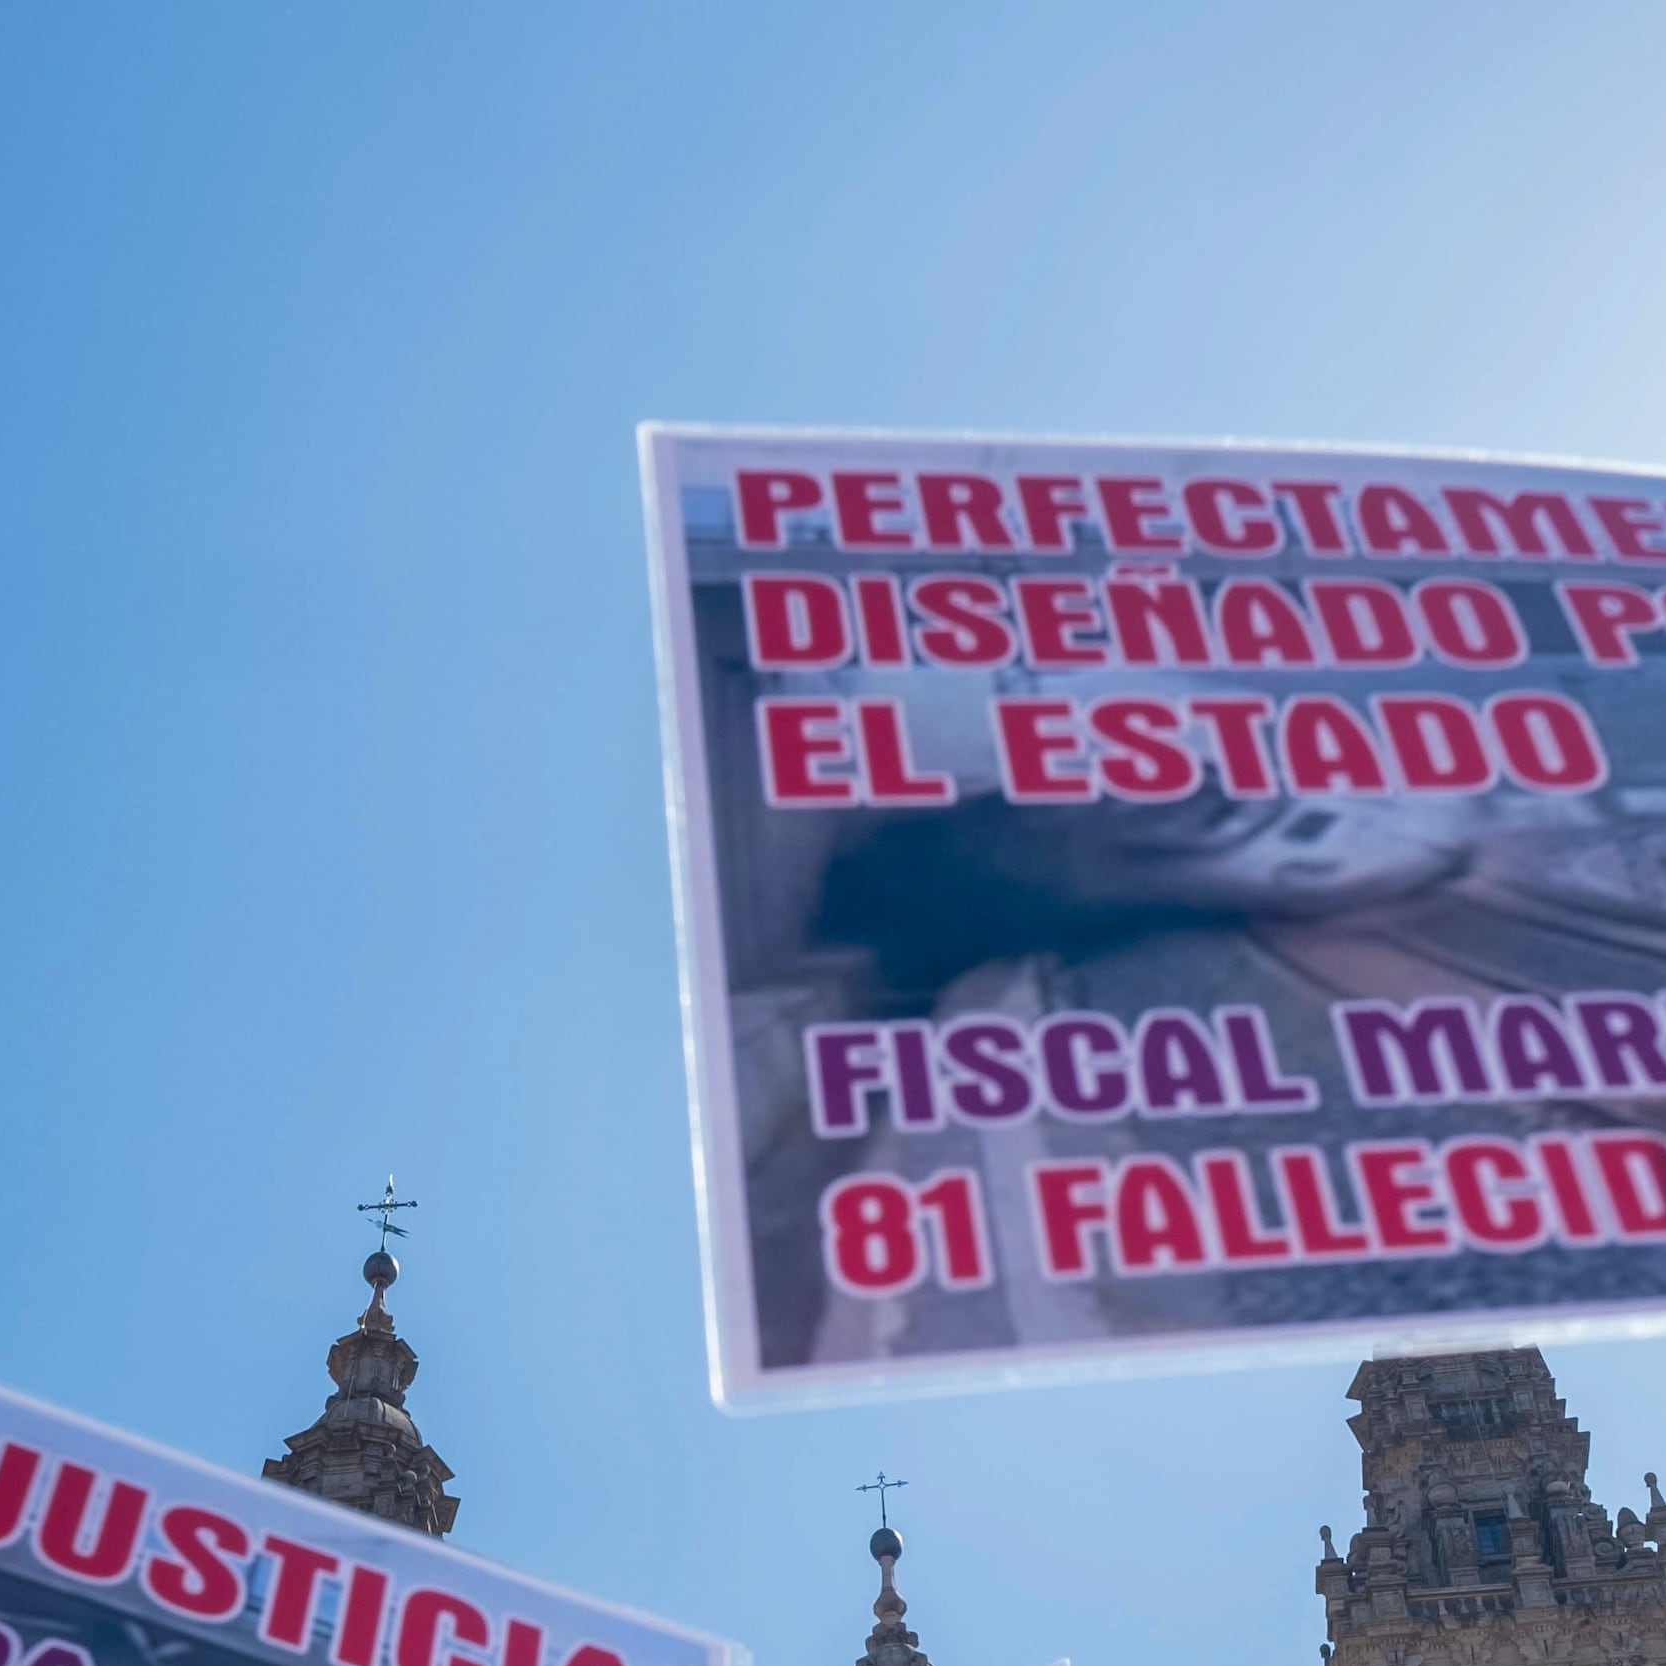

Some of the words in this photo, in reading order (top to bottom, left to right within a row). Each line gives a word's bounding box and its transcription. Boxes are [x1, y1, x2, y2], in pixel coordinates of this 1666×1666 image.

[743, 562, 1527, 670] DISEÑADO
[757, 694, 956, 806] EL
[994, 692, 1608, 802] ESTADO
[808, 1004, 1319, 1135] FISCAL
[821, 1170, 992, 1298] 81
